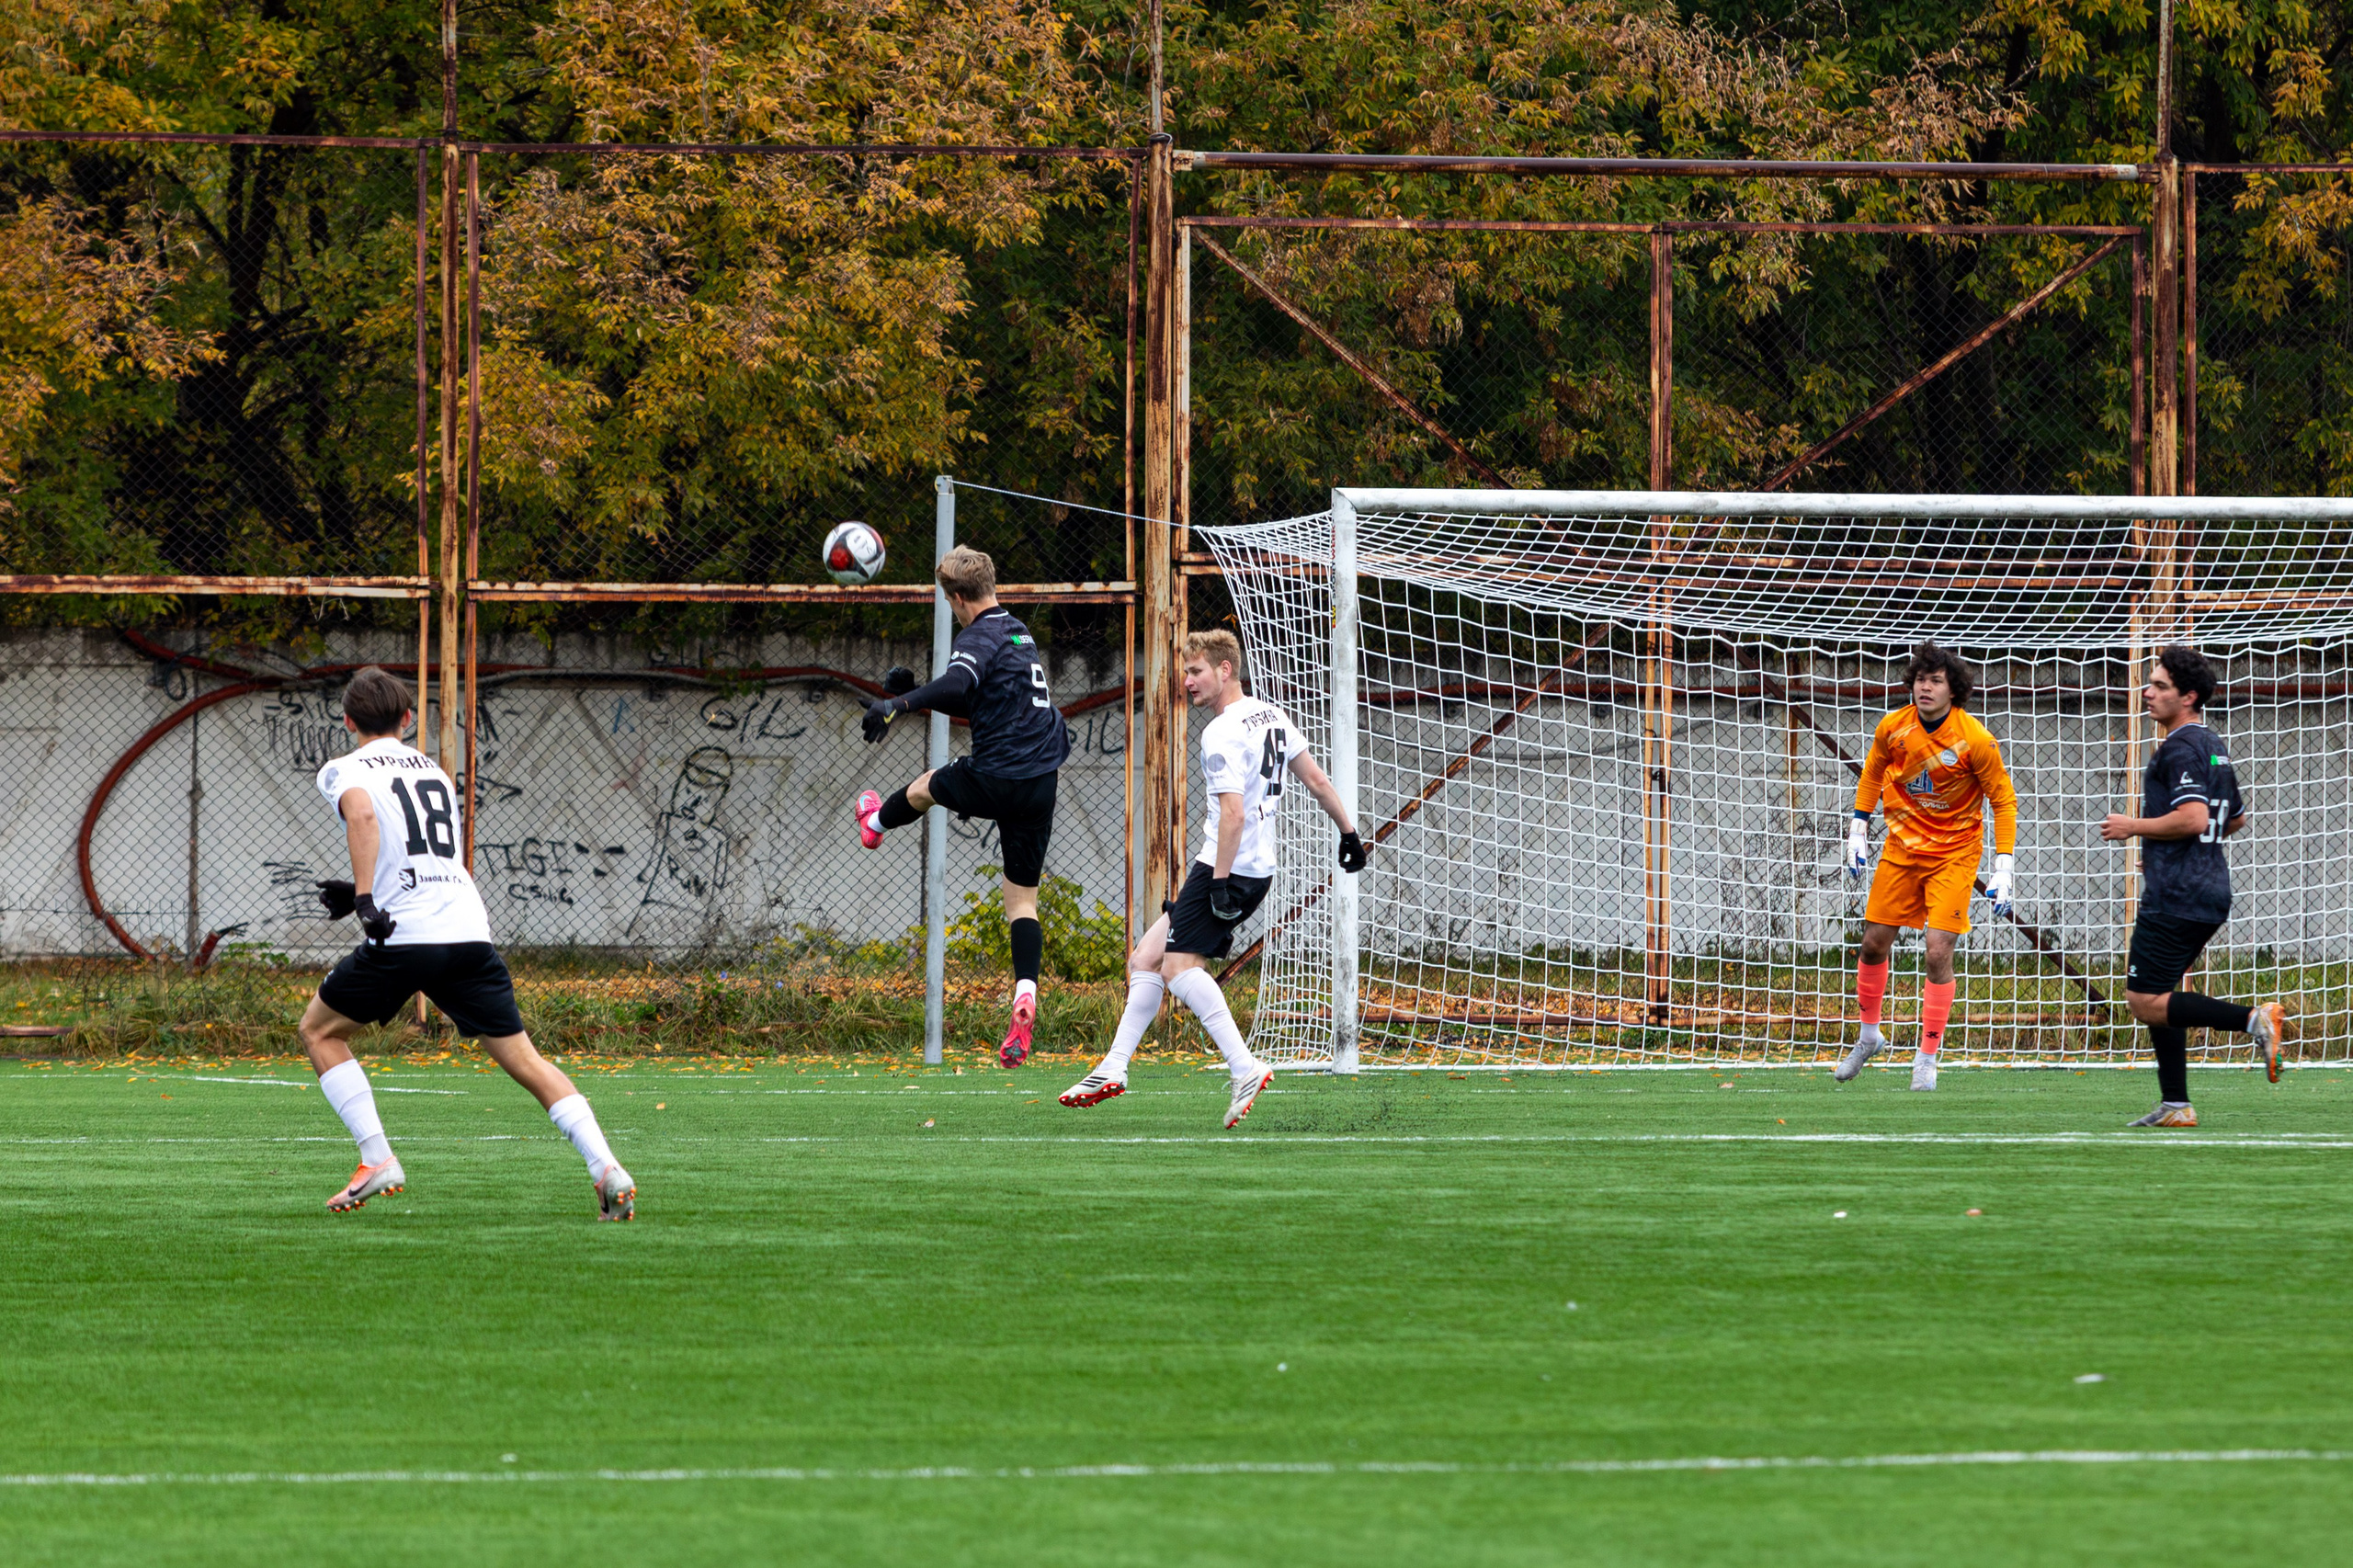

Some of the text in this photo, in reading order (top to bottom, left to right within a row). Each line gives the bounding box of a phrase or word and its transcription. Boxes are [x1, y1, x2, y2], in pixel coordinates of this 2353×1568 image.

[1030, 663, 1051, 709] 9
[358, 756, 438, 769] ТУРБИН
[1259, 728, 1287, 797] 45
[391, 777, 456, 858] 18
